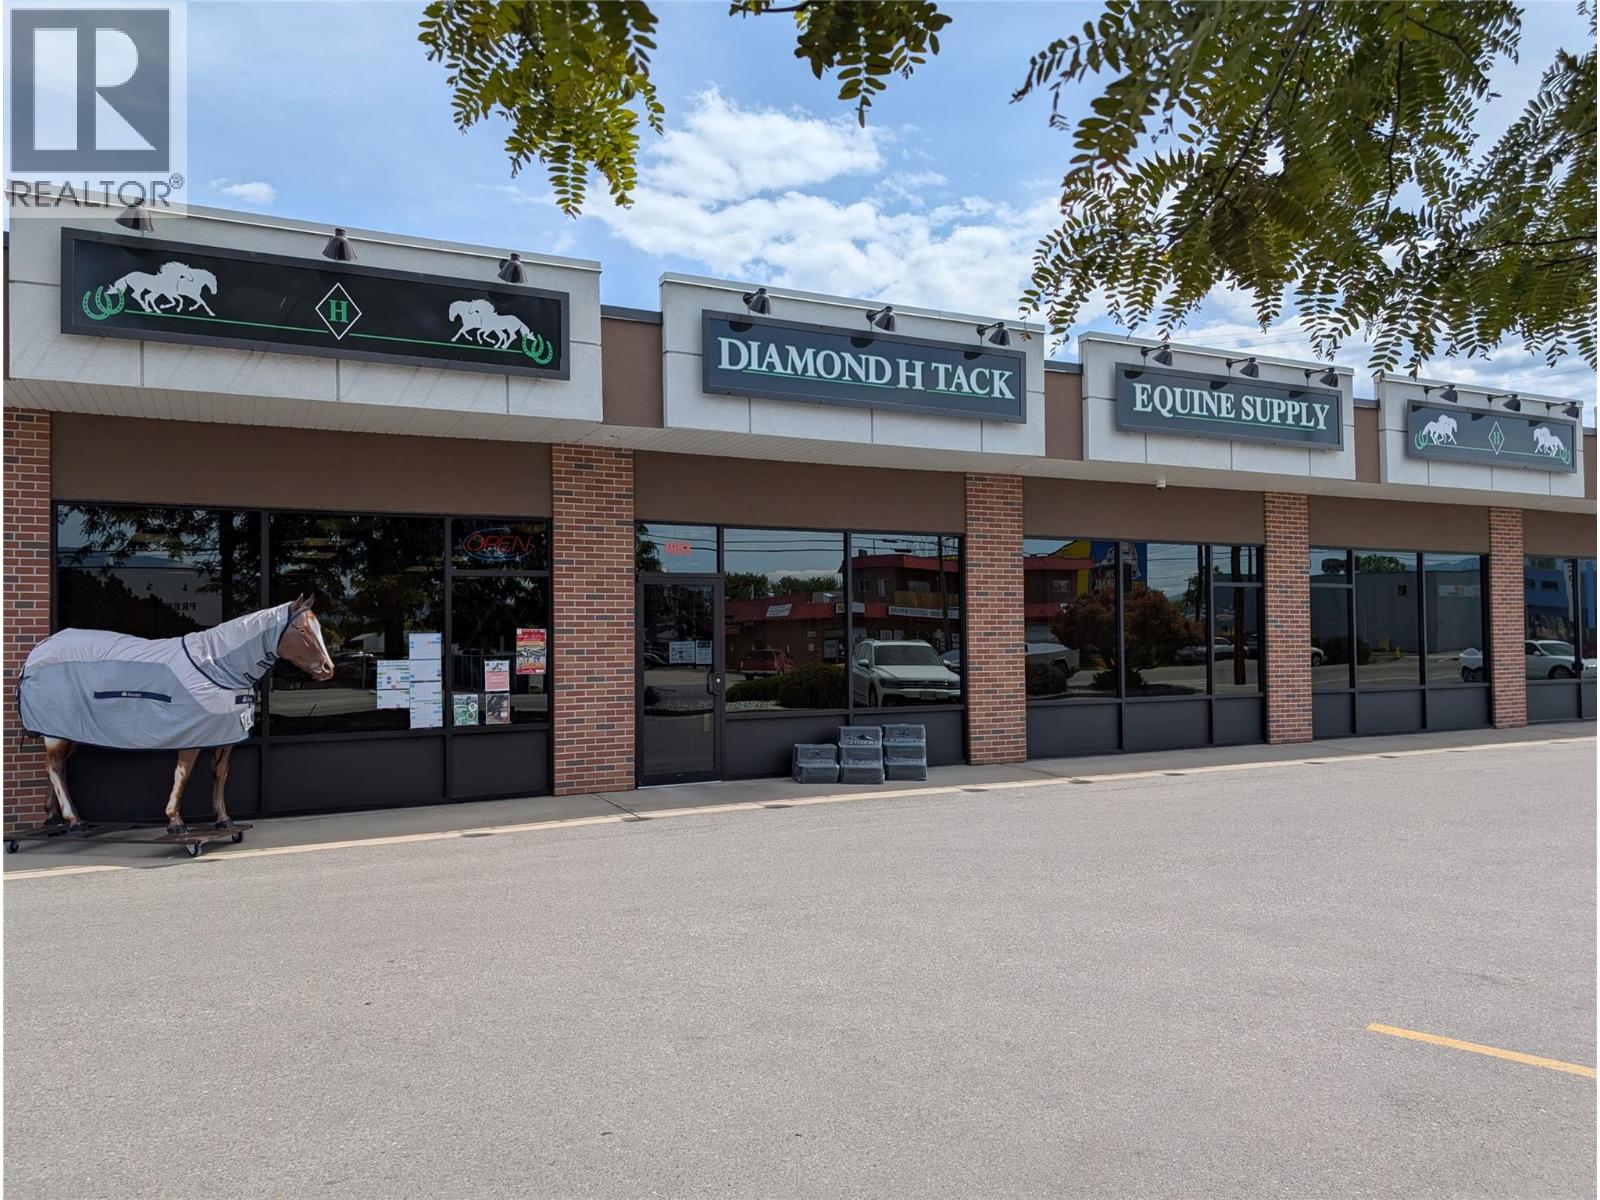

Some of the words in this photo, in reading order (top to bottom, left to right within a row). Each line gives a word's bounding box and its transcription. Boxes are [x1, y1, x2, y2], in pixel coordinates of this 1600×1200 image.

[328, 299, 349, 323] H
[717, 336, 892, 384] DIAMOND
[896, 358, 926, 390] H
[931, 362, 1015, 399] TACK
[1132, 382, 1236, 418] EQUINE
[1241, 395, 1330, 430] SUPPLY
[1493, 431, 1501, 445] H
[466, 534, 533, 552] OPEN
